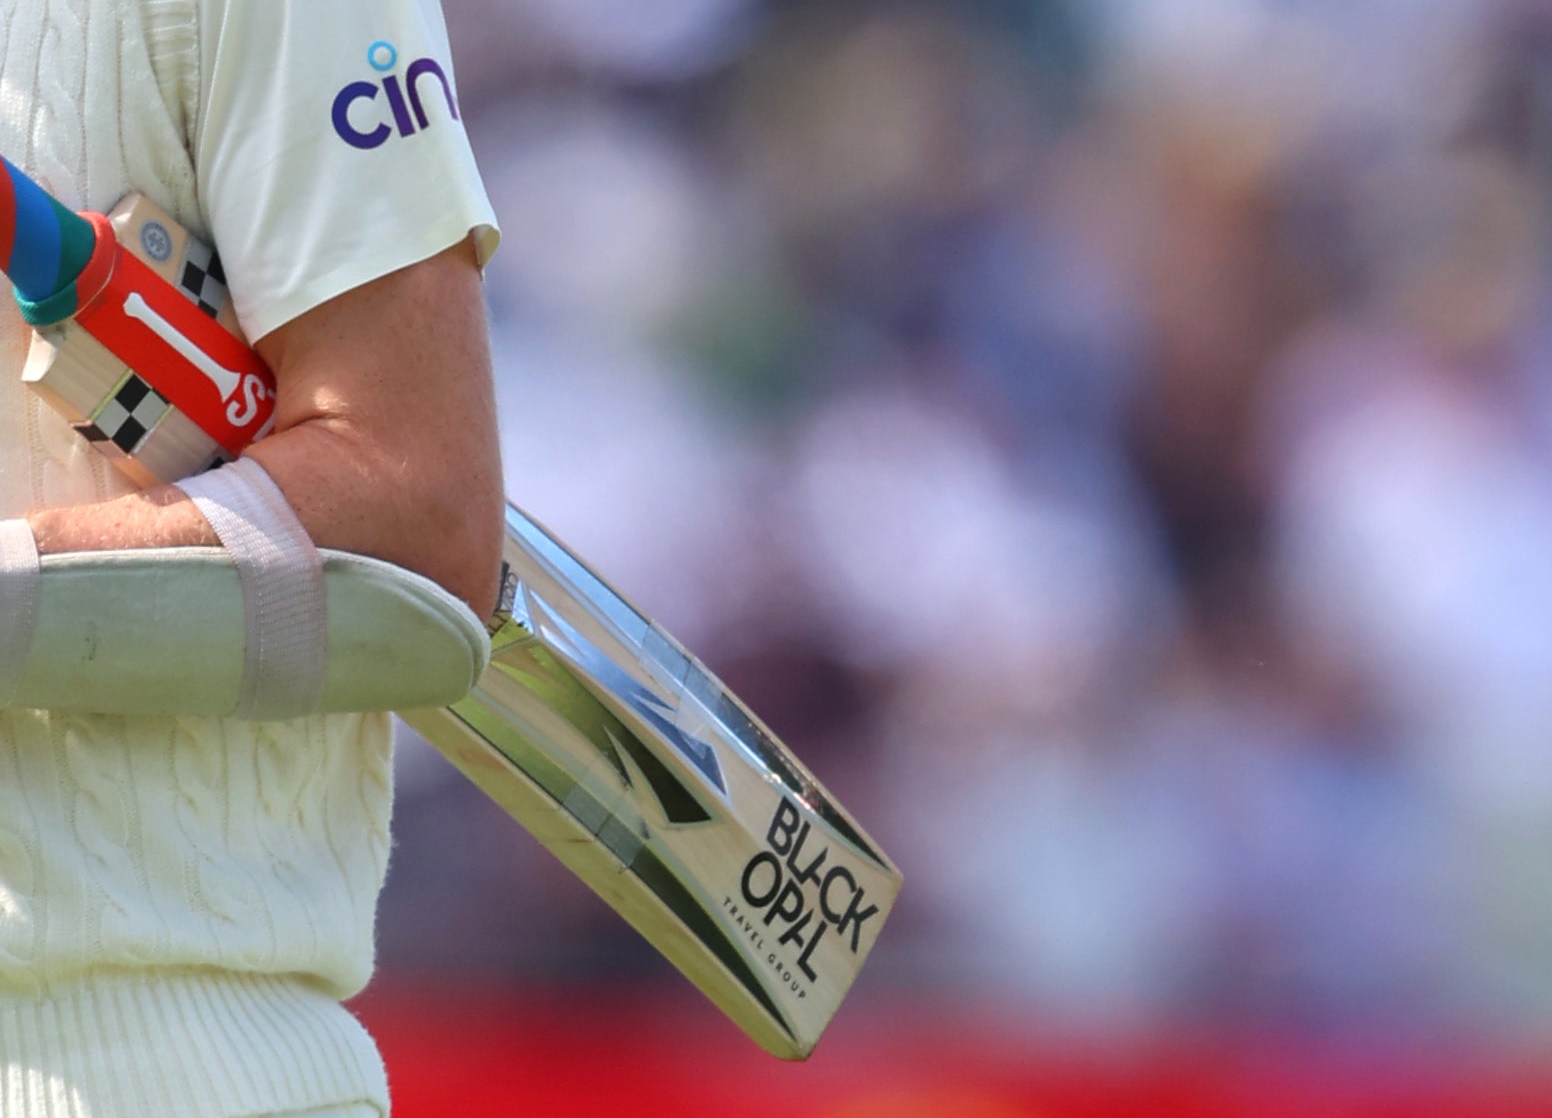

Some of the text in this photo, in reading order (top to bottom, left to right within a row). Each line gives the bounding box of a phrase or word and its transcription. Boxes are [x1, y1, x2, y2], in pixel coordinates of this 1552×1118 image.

[741, 851, 827, 983] OPAL
[767, 796, 879, 954] BLACK
[722, 896, 806, 999] TRAVEL GROUP
